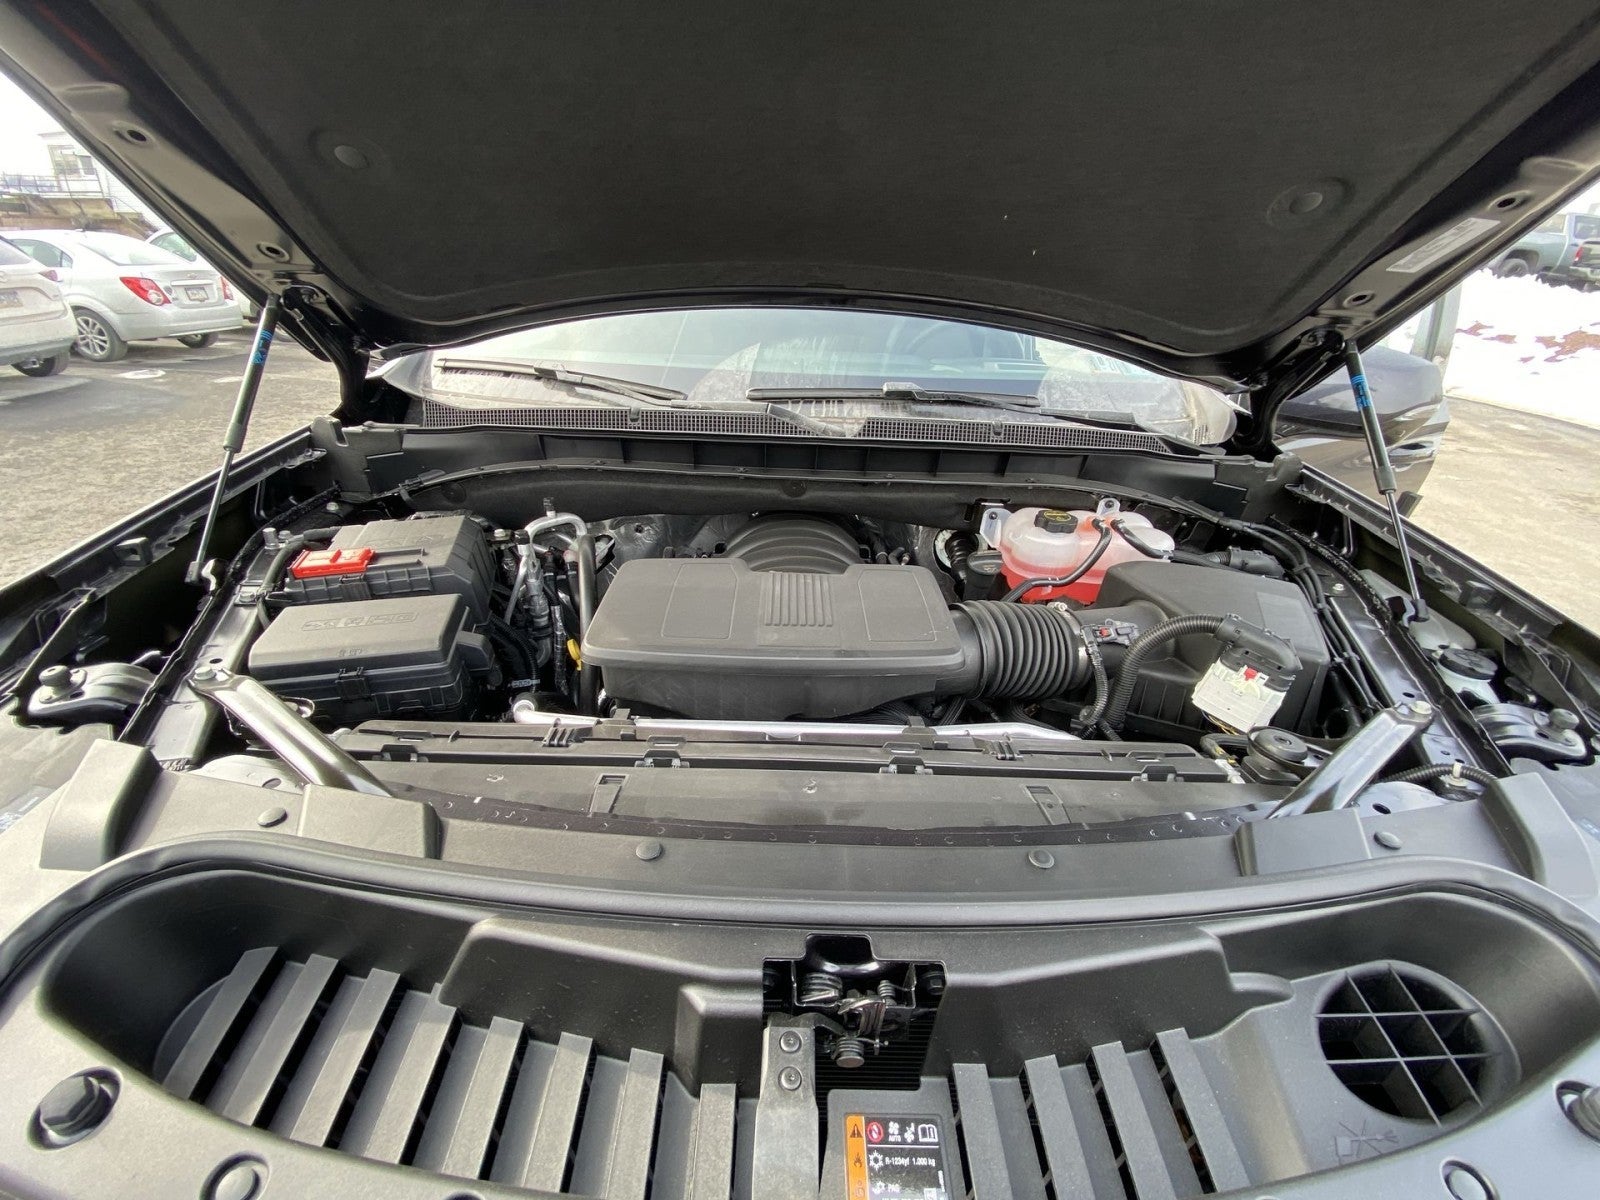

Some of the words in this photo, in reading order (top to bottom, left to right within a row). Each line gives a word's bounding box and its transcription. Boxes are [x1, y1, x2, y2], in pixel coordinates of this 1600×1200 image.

[888, 1135, 902, 1143] AUTO
[885, 1156, 910, 1167] R-1234yf
[928, 1157, 936, 1167] kg
